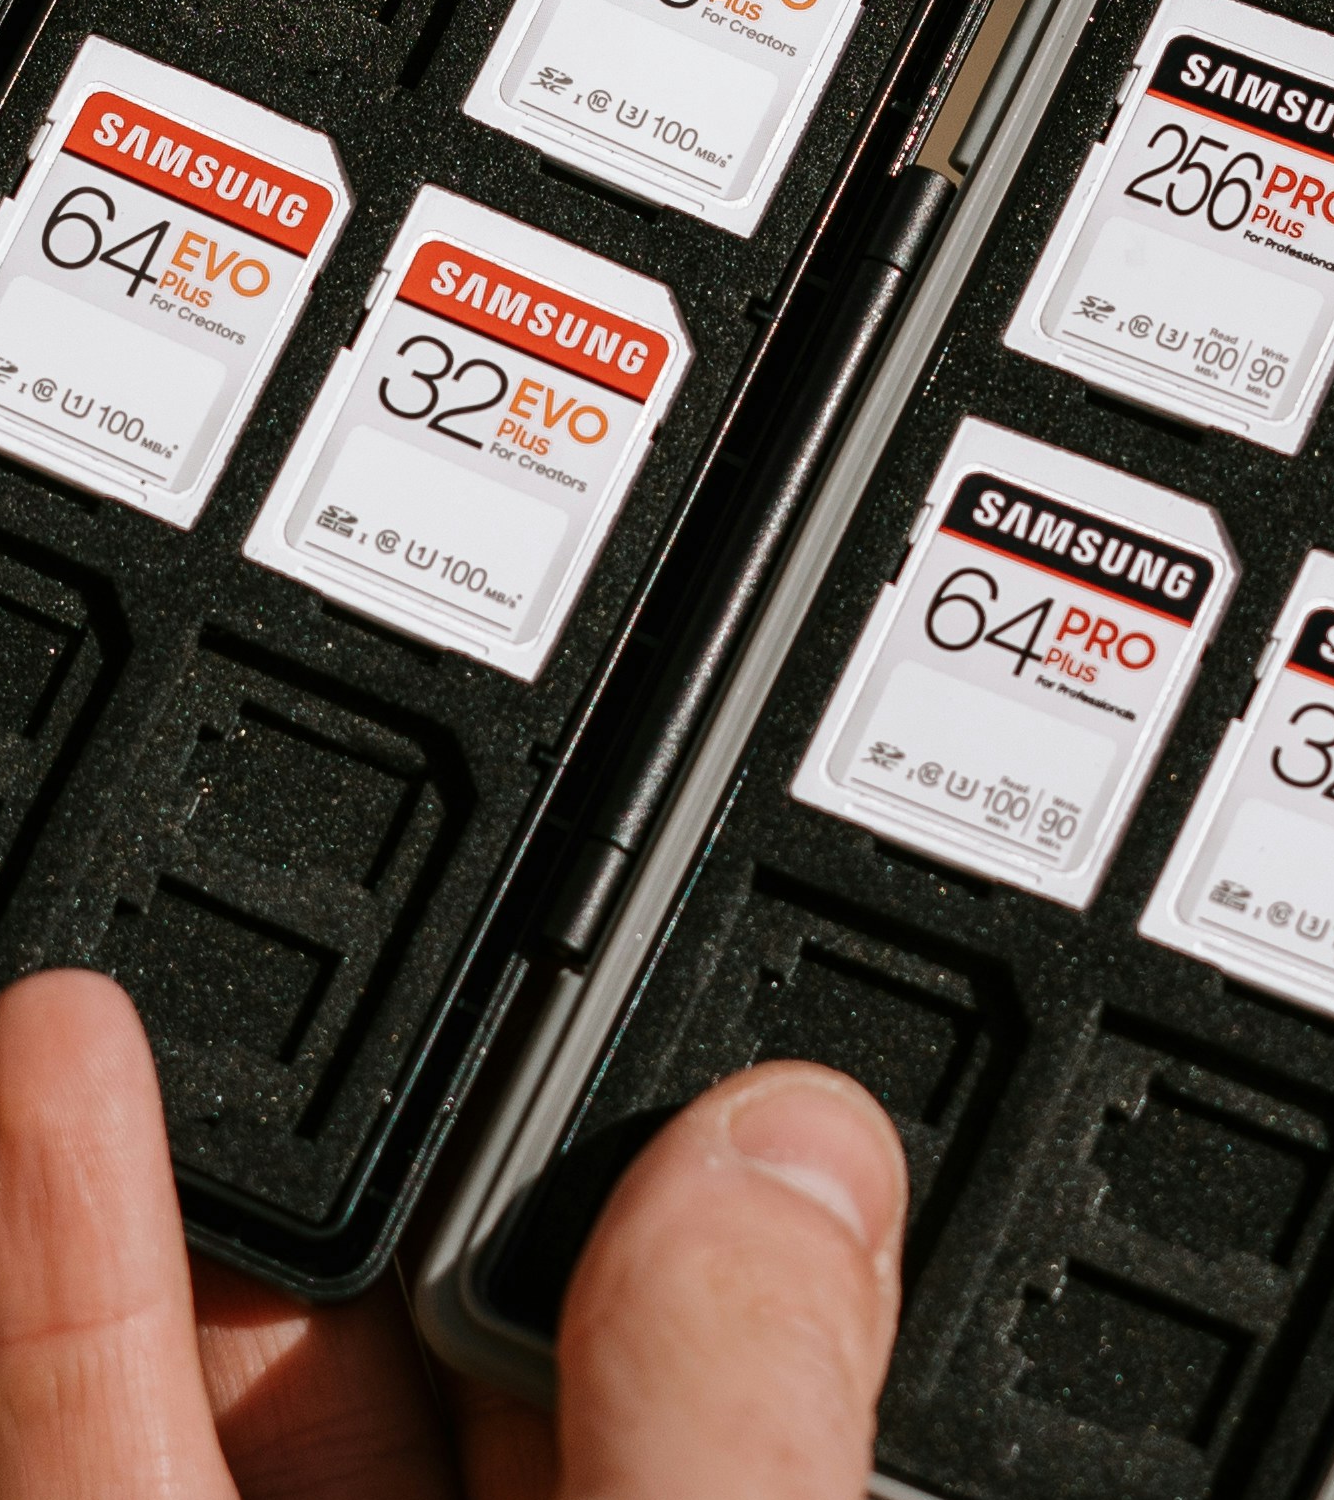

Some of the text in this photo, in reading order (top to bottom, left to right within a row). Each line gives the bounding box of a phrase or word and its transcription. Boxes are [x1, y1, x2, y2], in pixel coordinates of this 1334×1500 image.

[701, 6, 797, 57] For Creators
[652, 116, 699, 151] 100
[92, 112, 309, 228] SAMSUNG
[1124, 123, 1265, 232] 256
[41, 186, 272, 298] 64 EVO
[1243, 229, 1264, 247] For
[1251, 204, 1305, 239] Plus
[158, 269, 213, 309] Plus
[149, 293, 246, 345] For Creators
[430, 260, 648, 375] SAMSUNG
[1192, 337, 1239, 372] 100
[1247, 358, 1286, 389] 90
[1209, 327, 1290, 364] Read Write
[378, 334, 610, 450] 32 EVO
[97, 404, 145, 443] 100
[496, 417, 551, 457] Plus
[490, 442, 588, 493] For Creators
[972, 489, 1196, 600] SAMSUNG
[441, 555, 488, 593] 100
[925, 567, 1157, 677] 64 PRO
[1043, 646, 1098, 684] Plus
[983, 786, 1030, 822] 100
[1038, 807, 1077, 841] 90
